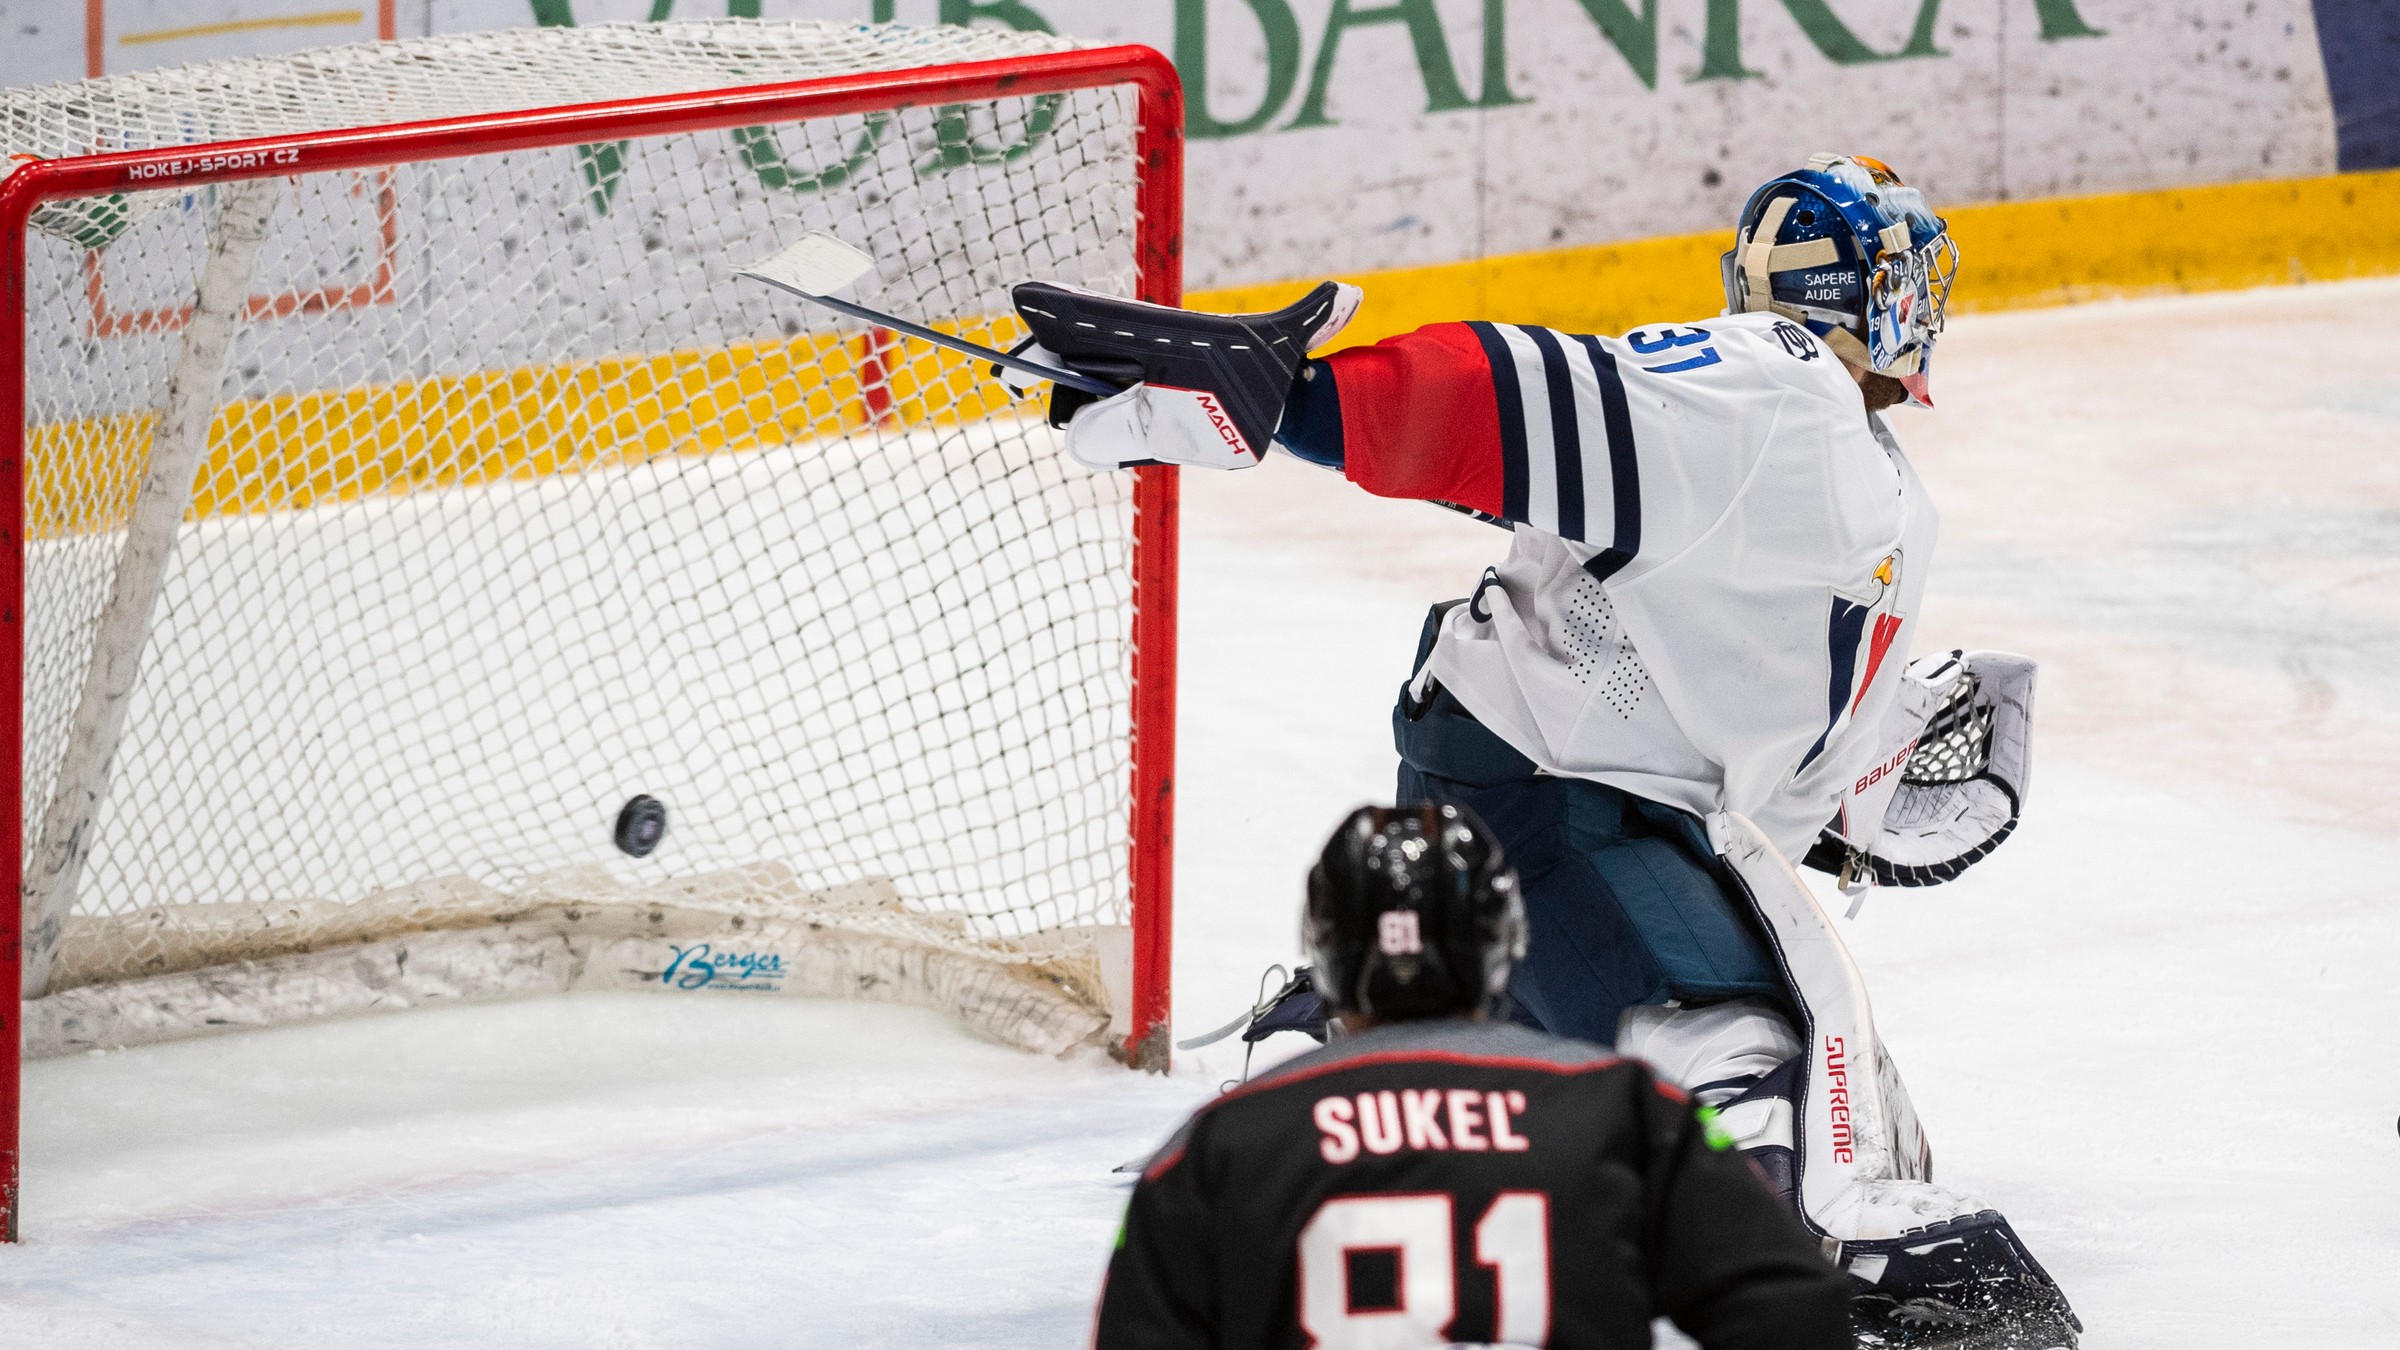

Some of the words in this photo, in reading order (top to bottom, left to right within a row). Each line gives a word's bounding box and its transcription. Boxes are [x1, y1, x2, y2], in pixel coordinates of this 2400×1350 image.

[129, 152, 268, 180] HOKEJ-SPORT
[274, 149, 300, 164] CZ
[1804, 271, 1857, 286] SAPERE
[1804, 288, 1841, 301] AUDE
[1196, 396, 1246, 455] MACH
[663, 943, 790, 990] Berger
